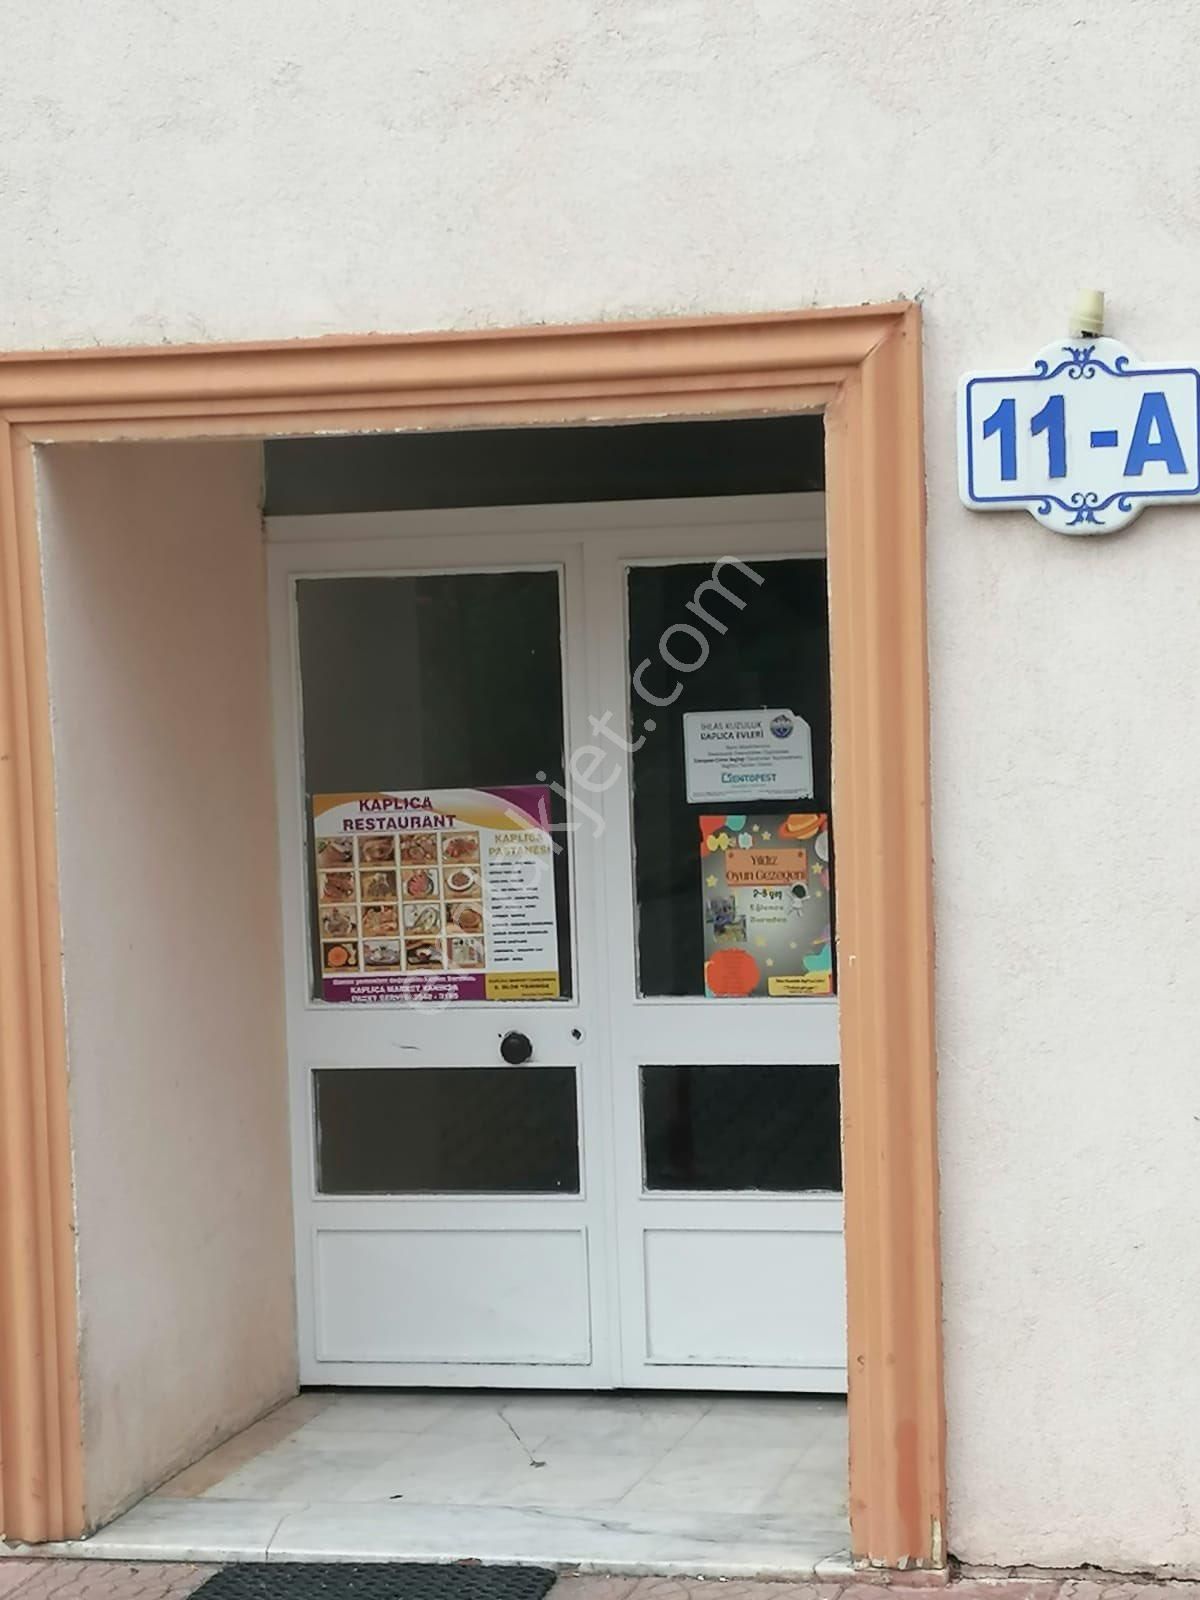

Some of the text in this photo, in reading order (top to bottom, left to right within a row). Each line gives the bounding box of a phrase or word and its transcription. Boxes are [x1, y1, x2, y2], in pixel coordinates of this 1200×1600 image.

[982, 391, 1189, 481] 11-A
[359, 796, 433, 812] KAPLICA
[343, 815, 456, 832] RESTAURANT
